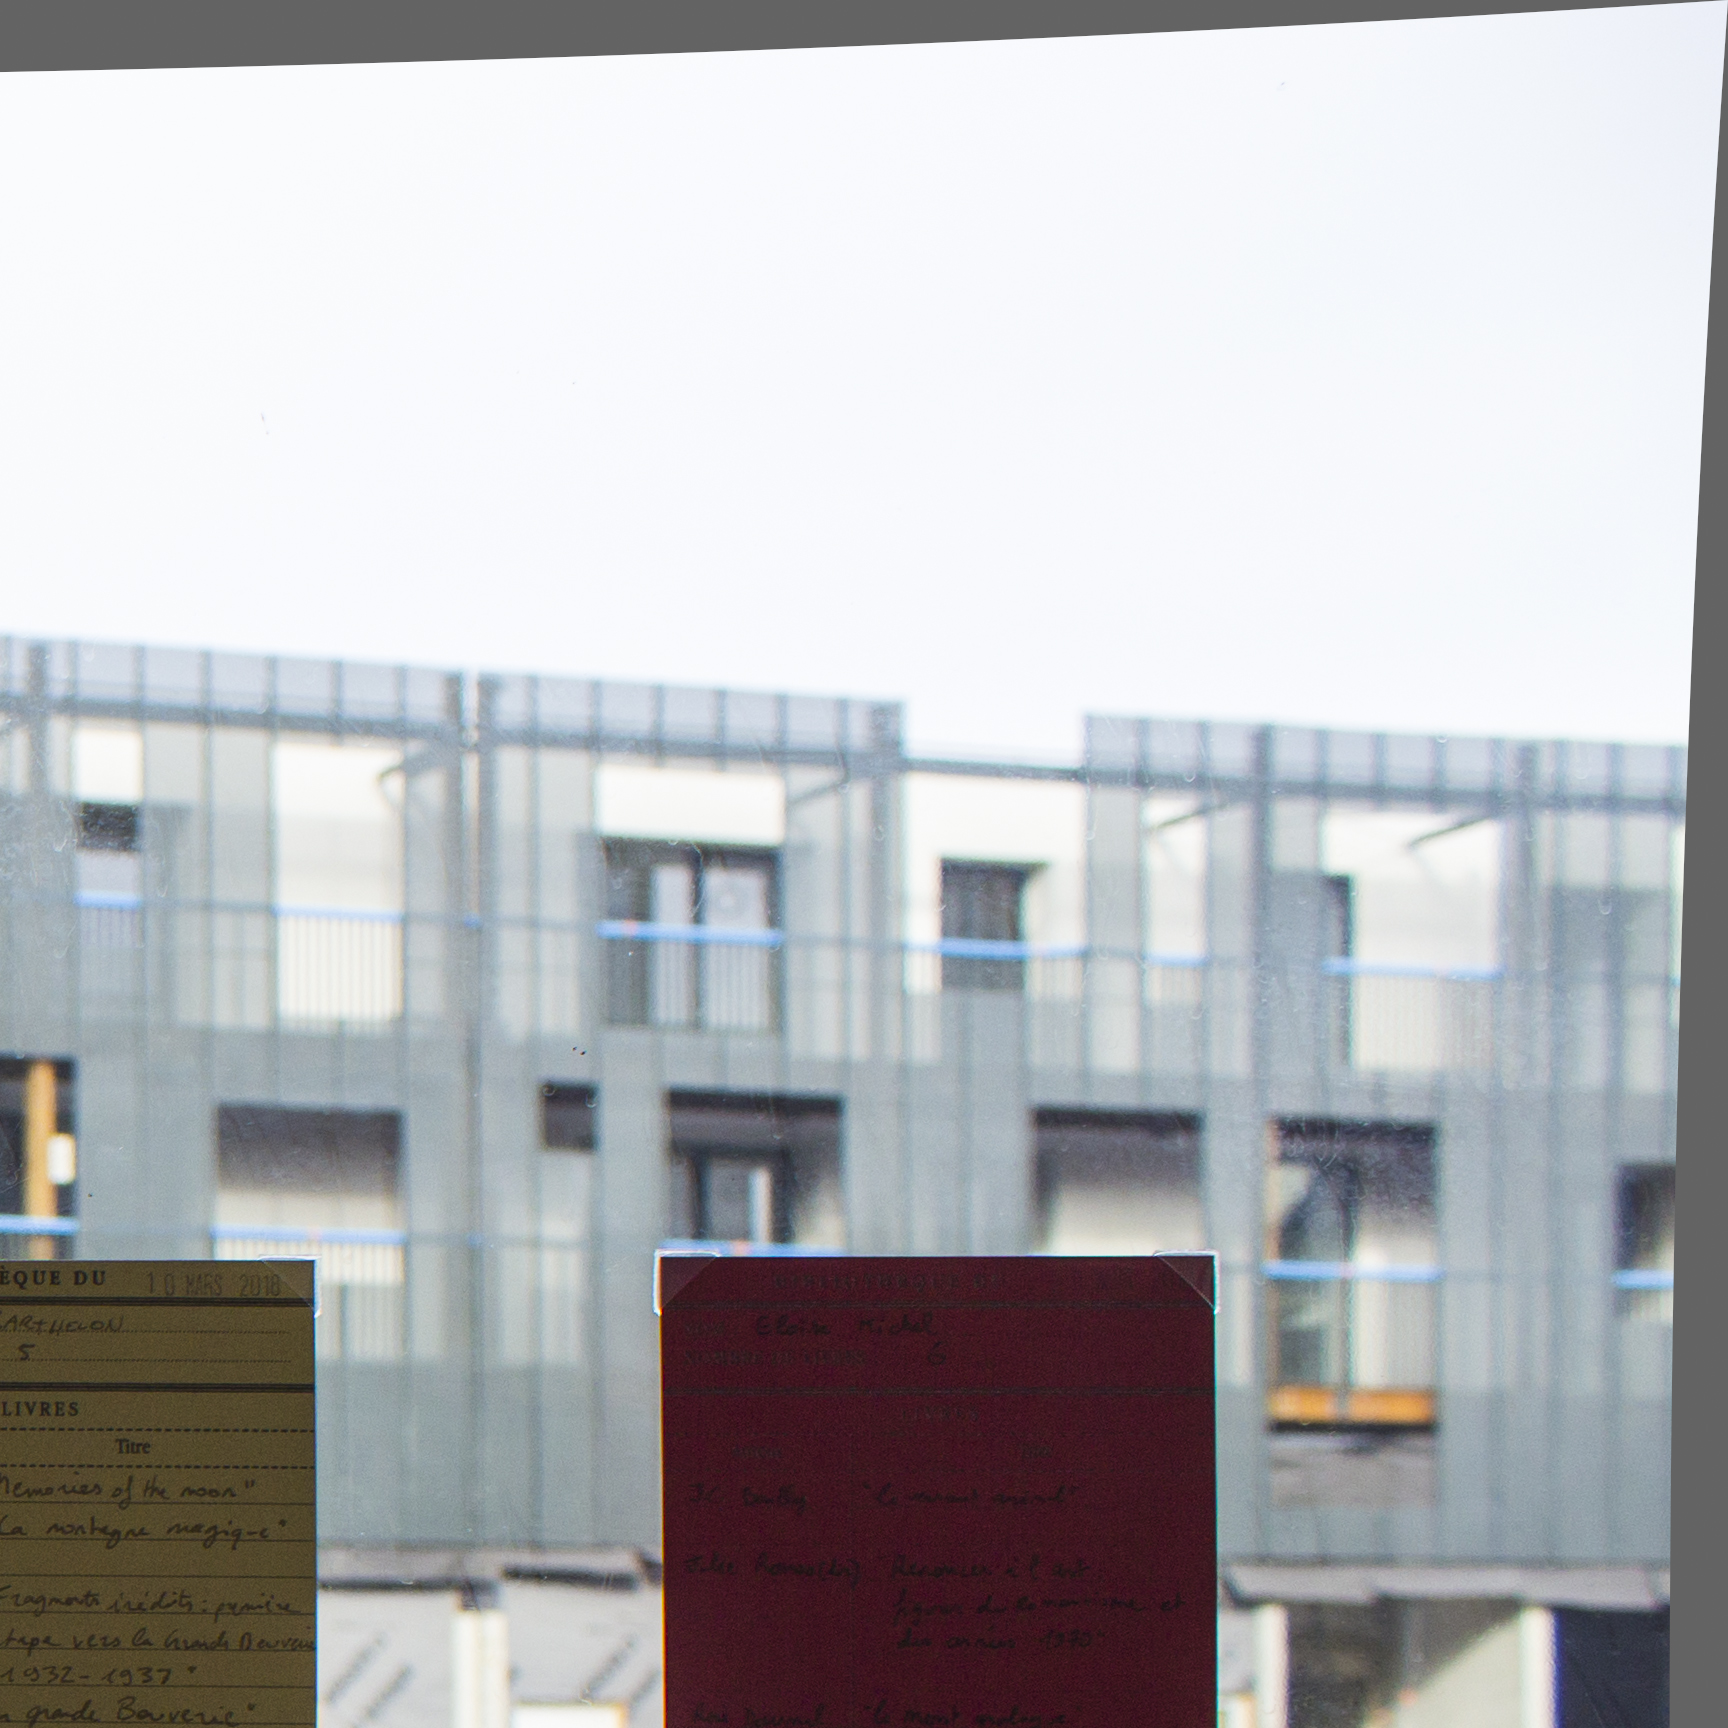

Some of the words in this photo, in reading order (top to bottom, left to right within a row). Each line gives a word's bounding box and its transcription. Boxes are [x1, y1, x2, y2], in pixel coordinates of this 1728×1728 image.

[74, 1271, 107, 1286] DU
[186, 1275, 222, 1295] MARS
[240, 1273, 282, 1296] 2018
[18, 1344, 36, 1361] 5
[2, 1402, 79, 1417] LIVRES
[116, 1439, 150, 1455] Titre
[112, 1475, 134, 1509] of
[142, 1473, 170, 1499] the
[73, 1630, 121, 1649] vers
